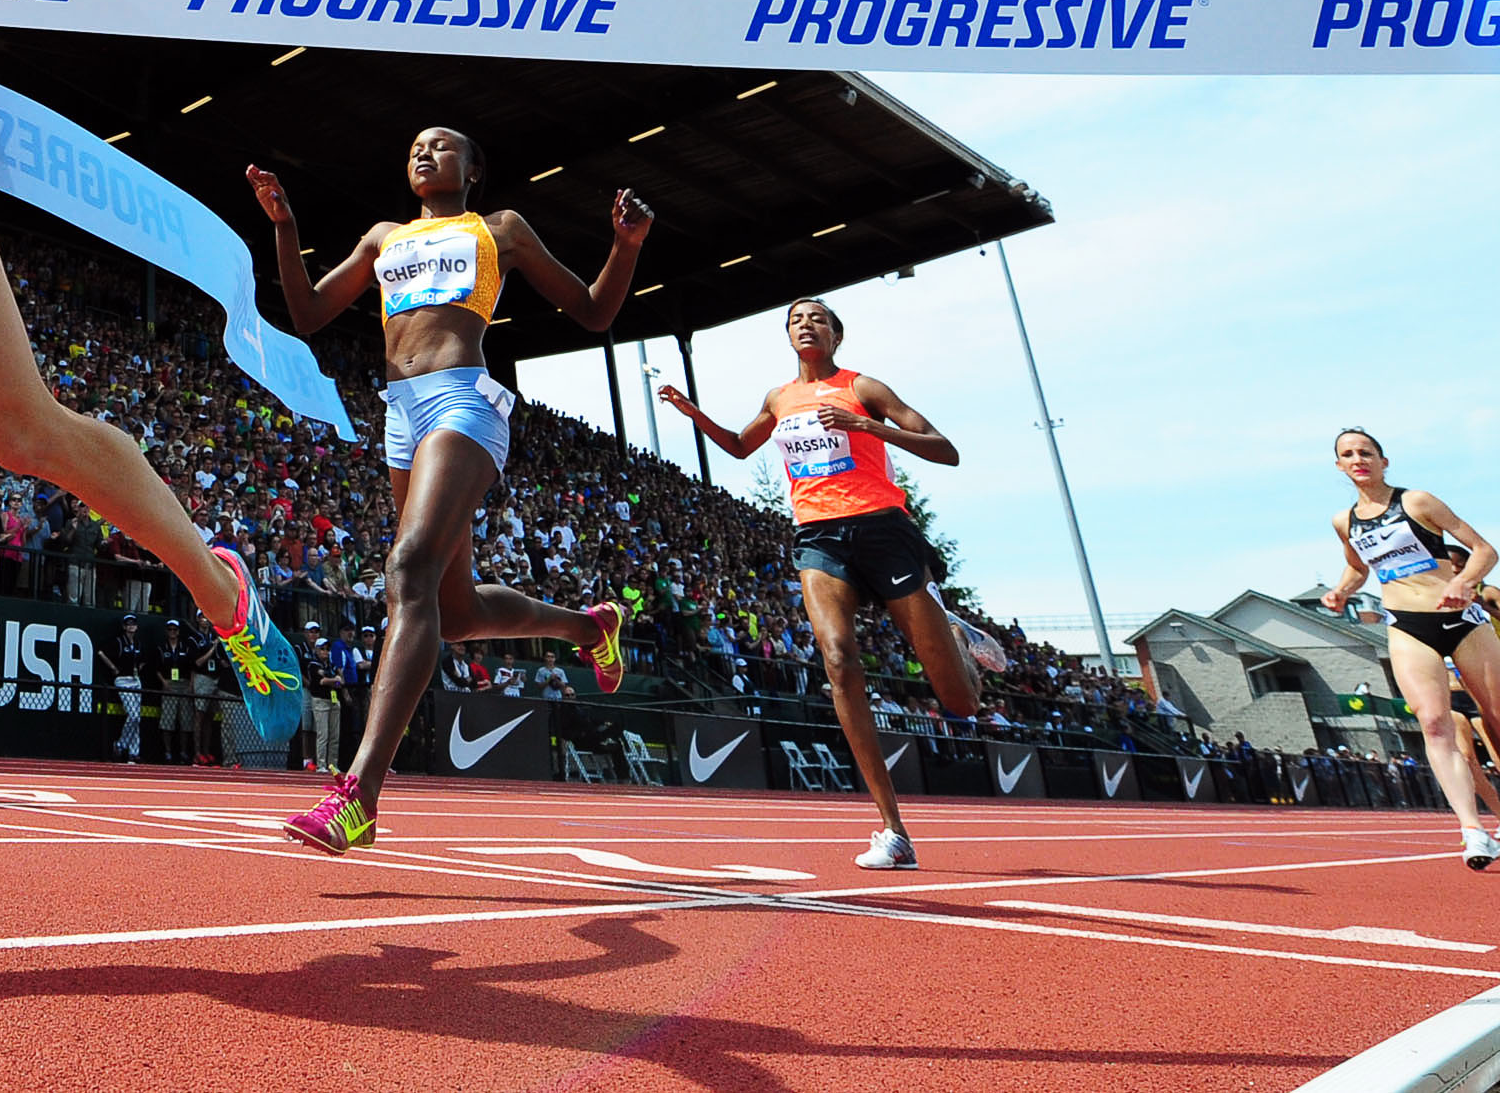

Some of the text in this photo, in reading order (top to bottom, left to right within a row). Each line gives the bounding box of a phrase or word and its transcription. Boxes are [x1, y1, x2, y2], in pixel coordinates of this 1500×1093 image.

[383, 258, 467, 282] CHERONO
[410, 290, 462, 305] Eugene
[785, 436, 840, 454] HASSAN
[808, 461, 846, 476] Eugene
[1355, 534, 1378, 551] PRE
